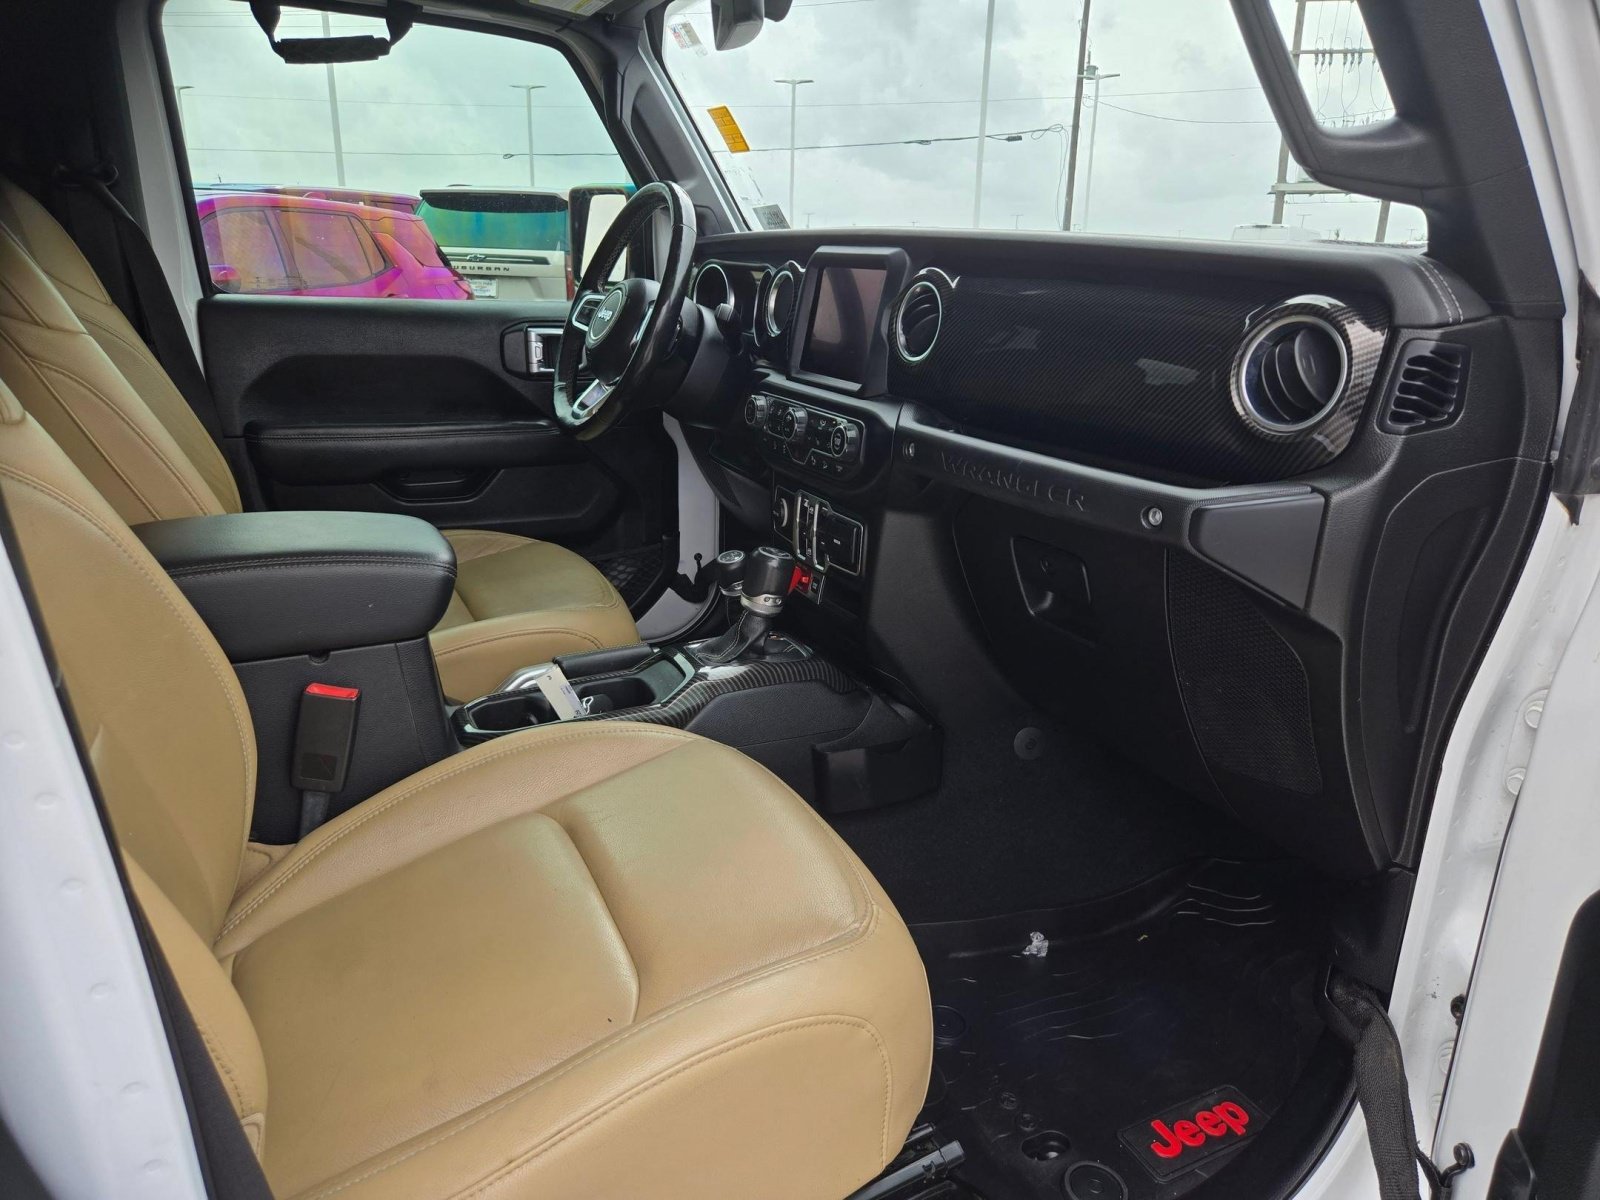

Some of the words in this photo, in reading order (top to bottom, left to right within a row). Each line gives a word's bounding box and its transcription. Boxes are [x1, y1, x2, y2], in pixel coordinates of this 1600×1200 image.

[598, 306, 613, 322] Jeep
[940, 451, 1087, 511] WRANGLER
[1150, 1101, 1249, 1159] Jeep
